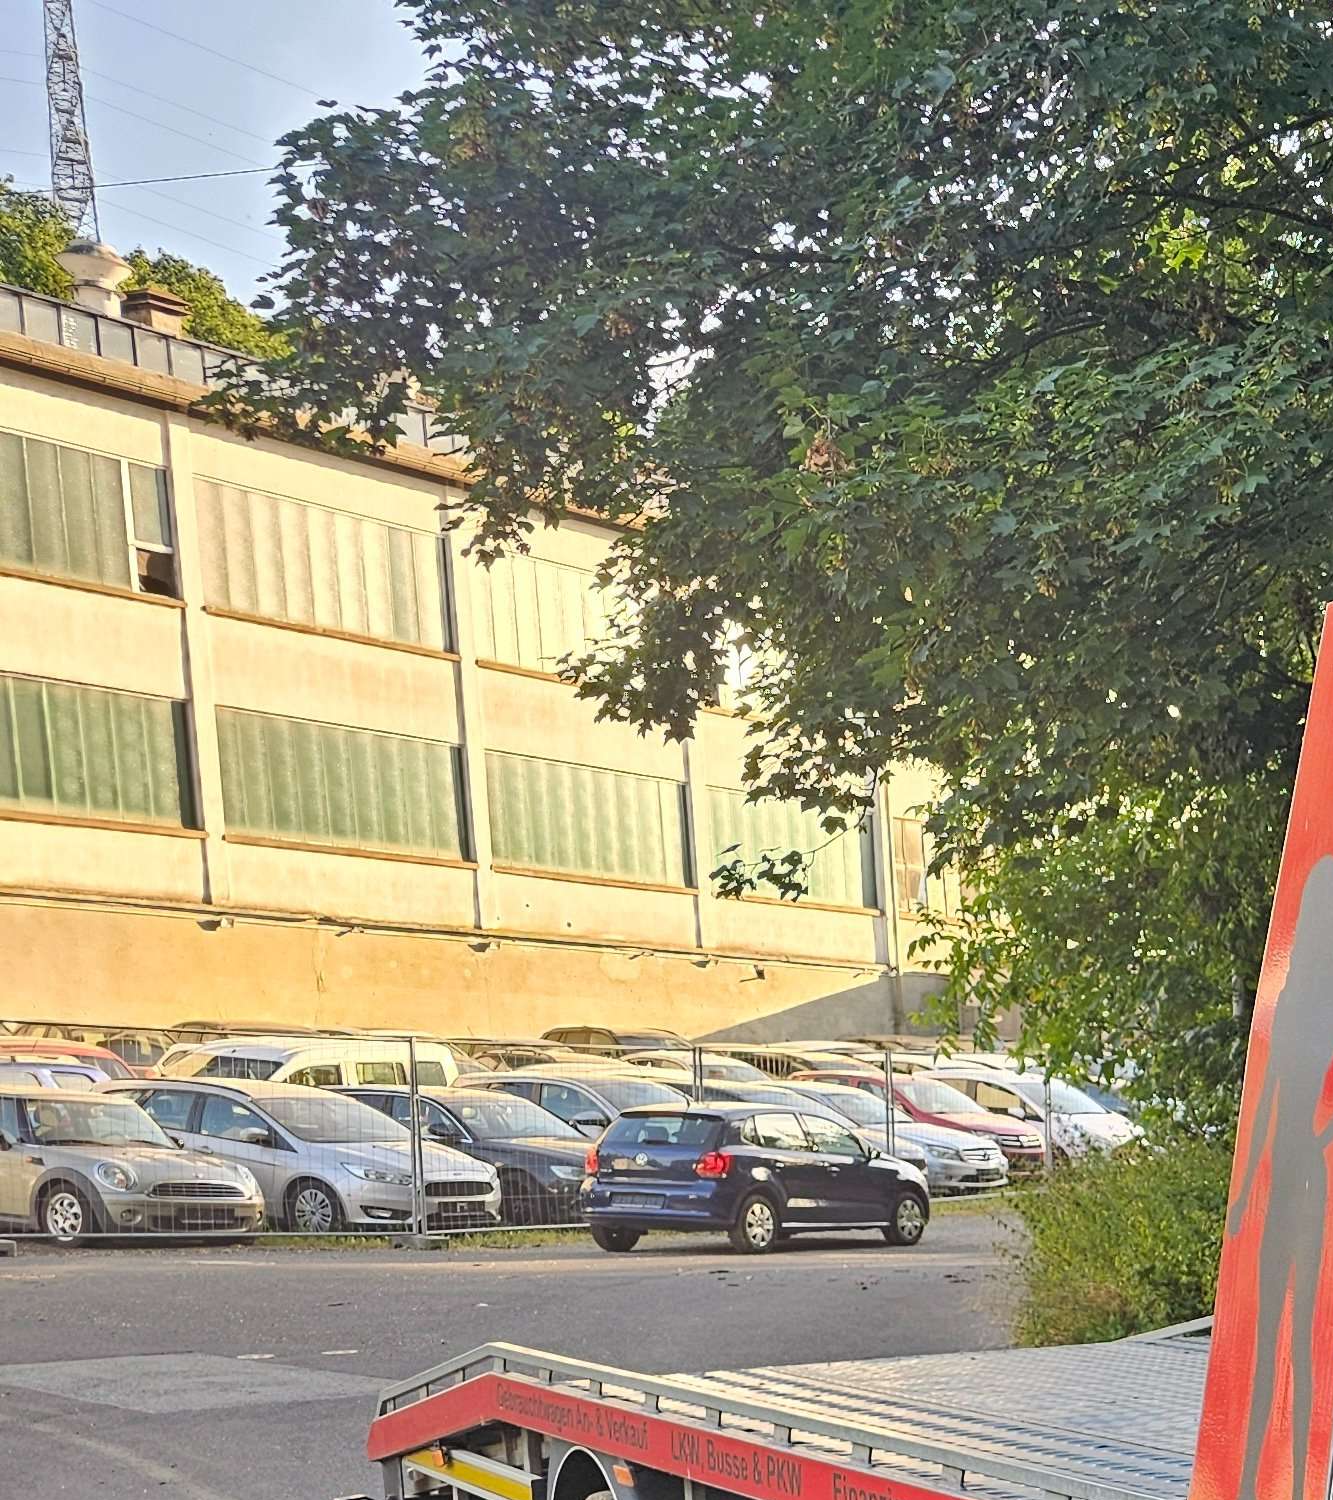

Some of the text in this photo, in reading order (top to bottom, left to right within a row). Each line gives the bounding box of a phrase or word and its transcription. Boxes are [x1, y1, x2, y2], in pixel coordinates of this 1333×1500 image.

[605, 1411, 648, 1450] Verkauf
[706, 1438, 748, 1480] Busse
[752, 1452, 762, 1491] &
[767, 1455, 801, 1497] PKW
